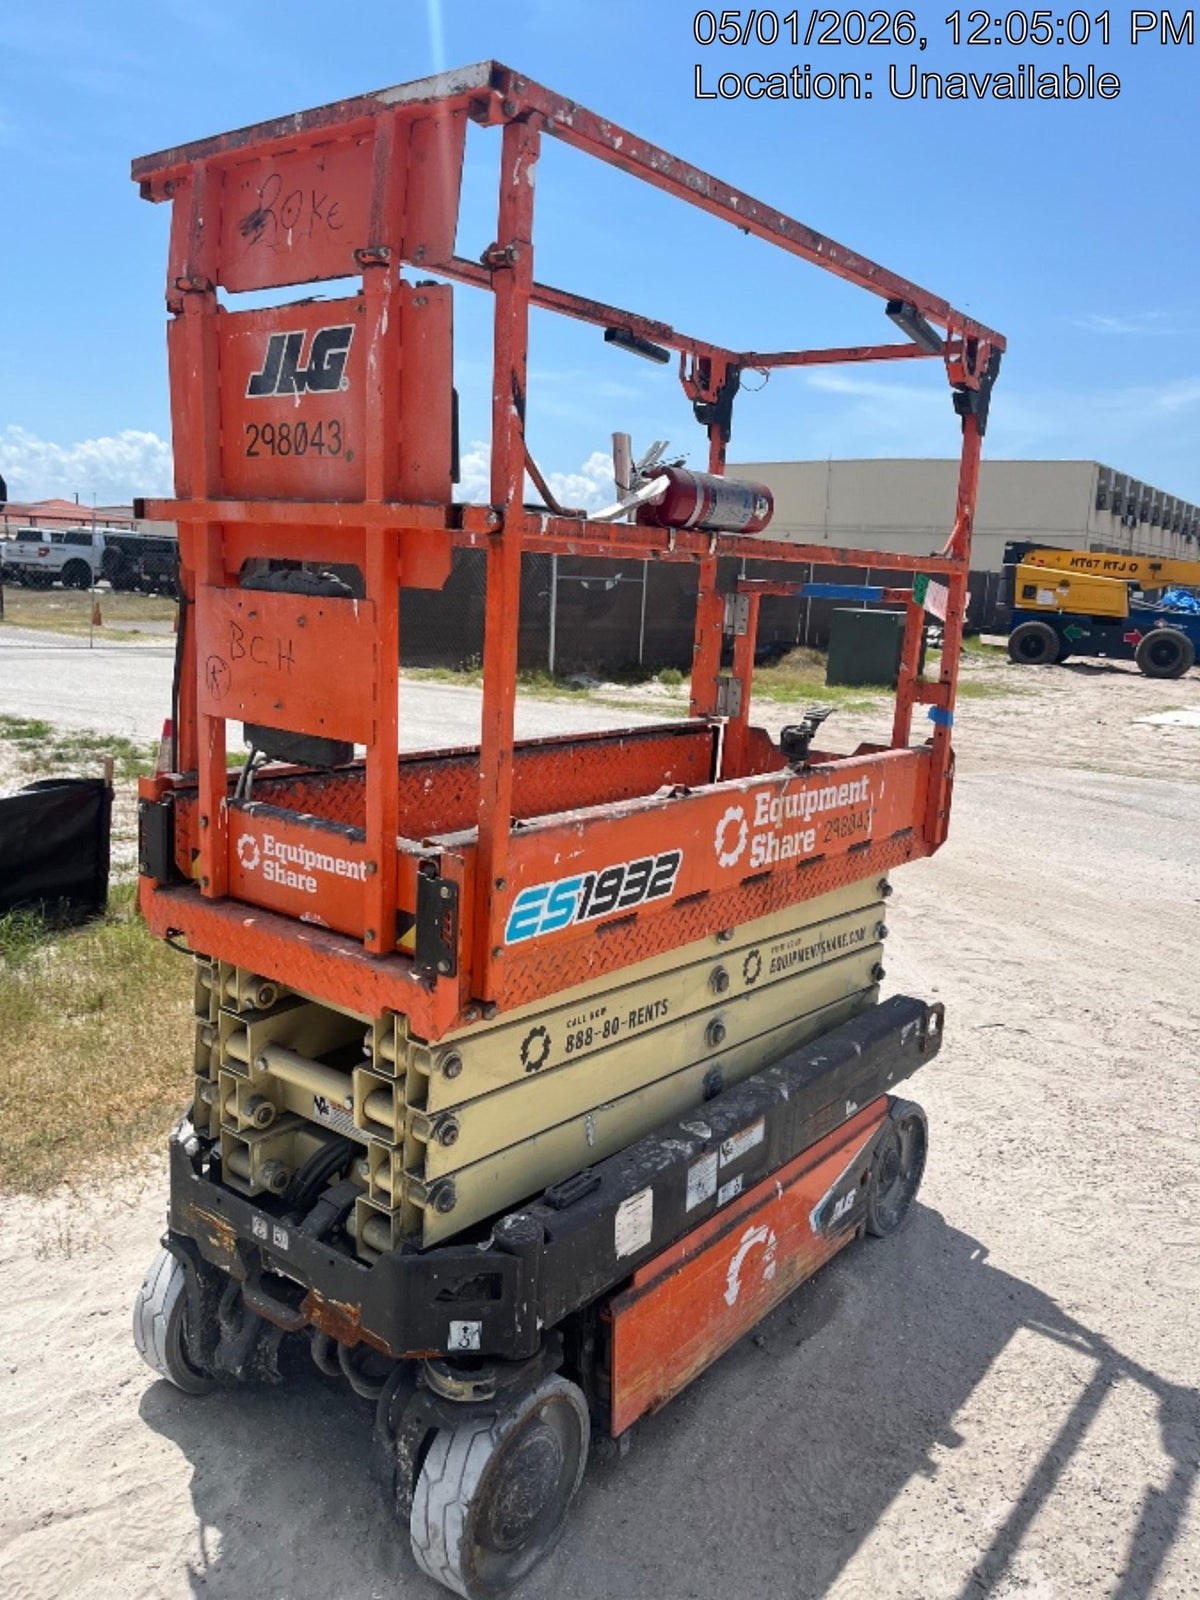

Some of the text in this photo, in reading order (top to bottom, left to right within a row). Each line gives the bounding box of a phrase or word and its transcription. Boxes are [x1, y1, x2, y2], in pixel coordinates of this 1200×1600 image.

[245, 323, 356, 399] JLG
[245, 420, 343, 457] 298043
[754, 775, 871, 829] Equipment
[262, 833, 368, 882] Equipment
[750, 828, 816, 868] Share
[262, 859, 318, 894] Share
[505, 848, 683, 945] ES1932
[565, 998, 669, 1053] 888-80-RENTS
